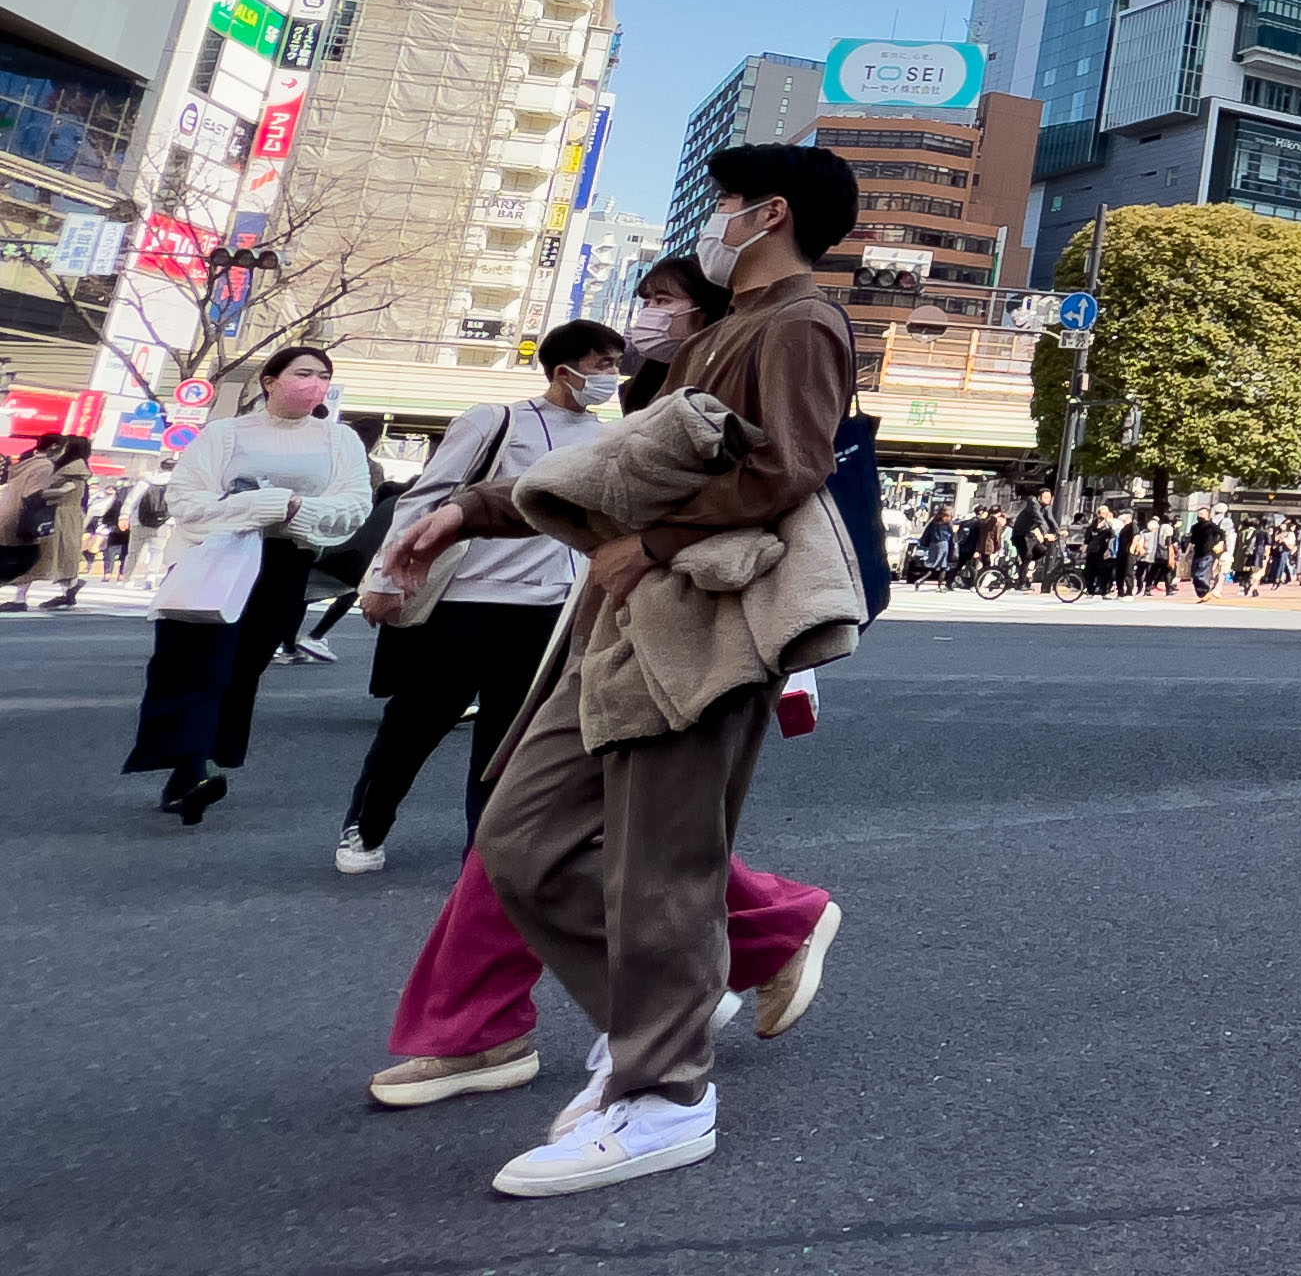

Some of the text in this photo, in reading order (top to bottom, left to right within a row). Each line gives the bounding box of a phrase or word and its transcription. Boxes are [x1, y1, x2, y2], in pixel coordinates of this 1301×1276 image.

[864, 65, 944, 82] TOSEI
[860, 82, 941, 96] トーセイ株式会社
[263, 112, 291, 152] アコム
[497, 209, 524, 220] BAR
